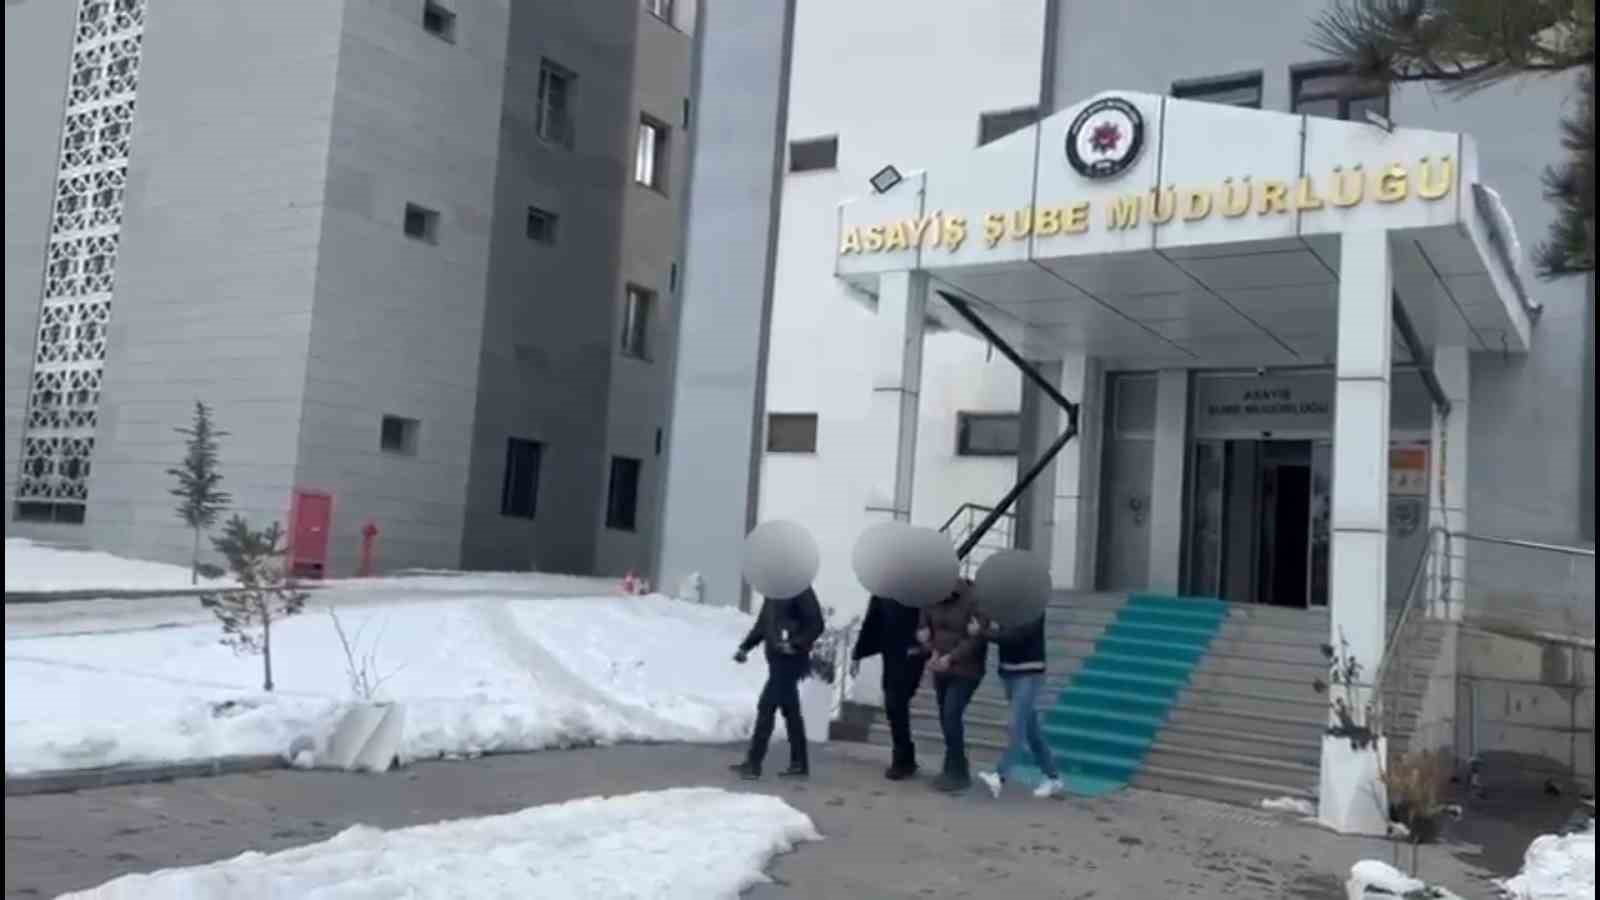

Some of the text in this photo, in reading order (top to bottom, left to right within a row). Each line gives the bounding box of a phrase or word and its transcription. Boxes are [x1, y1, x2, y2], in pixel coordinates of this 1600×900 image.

[840, 154, 1454, 254] ASAYİŞ ŞUBE MÜDÜRLÜĞÜ
